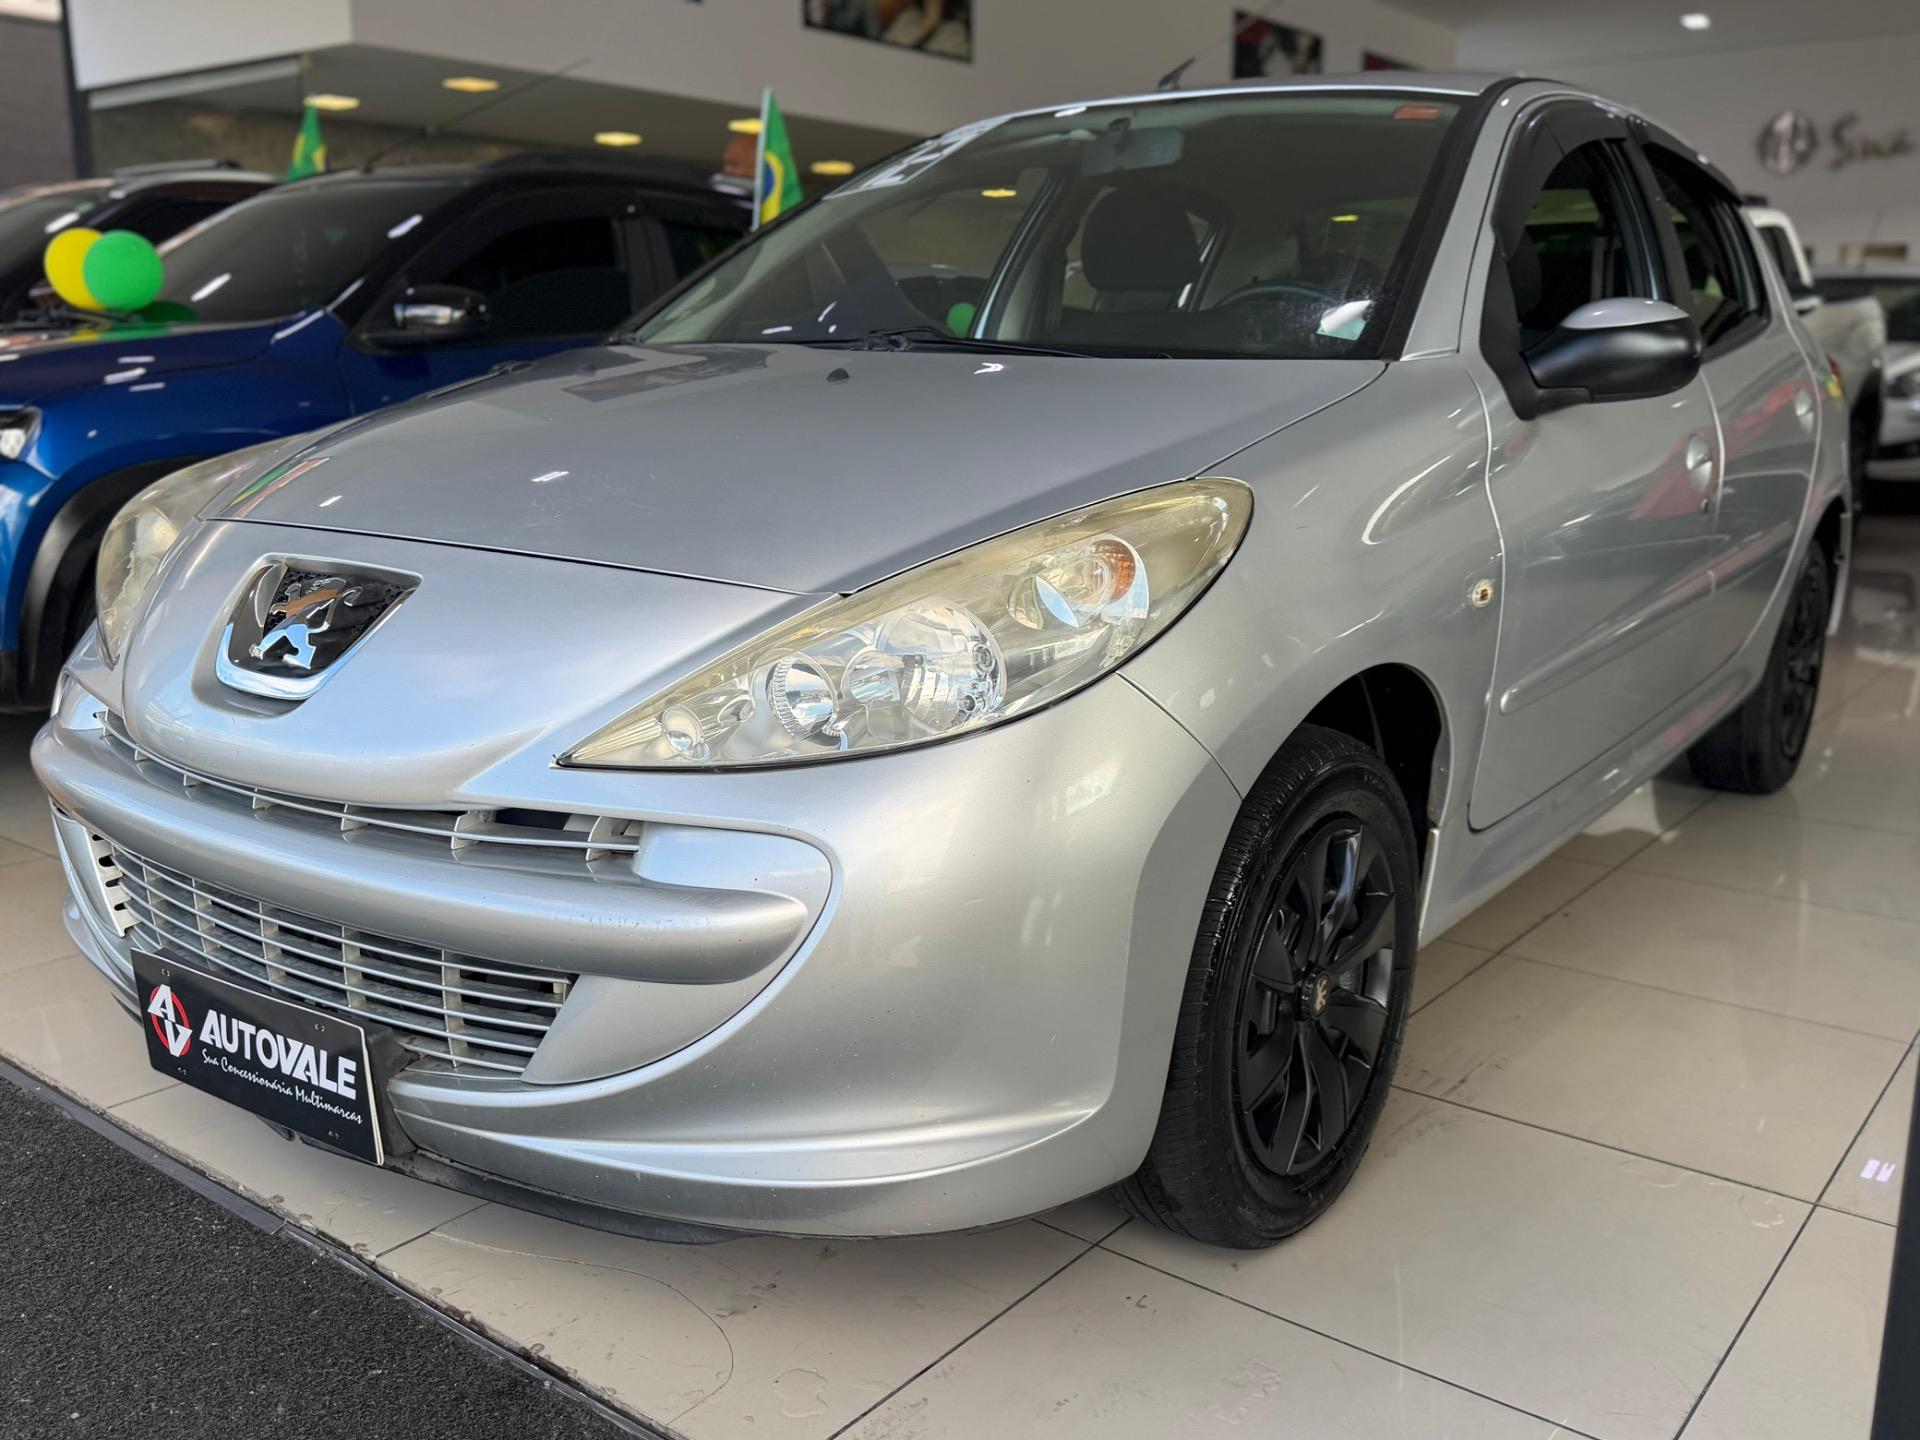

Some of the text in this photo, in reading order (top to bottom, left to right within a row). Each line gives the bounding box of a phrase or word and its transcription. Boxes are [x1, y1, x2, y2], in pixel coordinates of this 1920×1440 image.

[199, 1009, 356, 1100] AUTOVALE
[201, 1048, 220, 1066] Sua
[295, 1085, 363, 1125] Multimarcas
